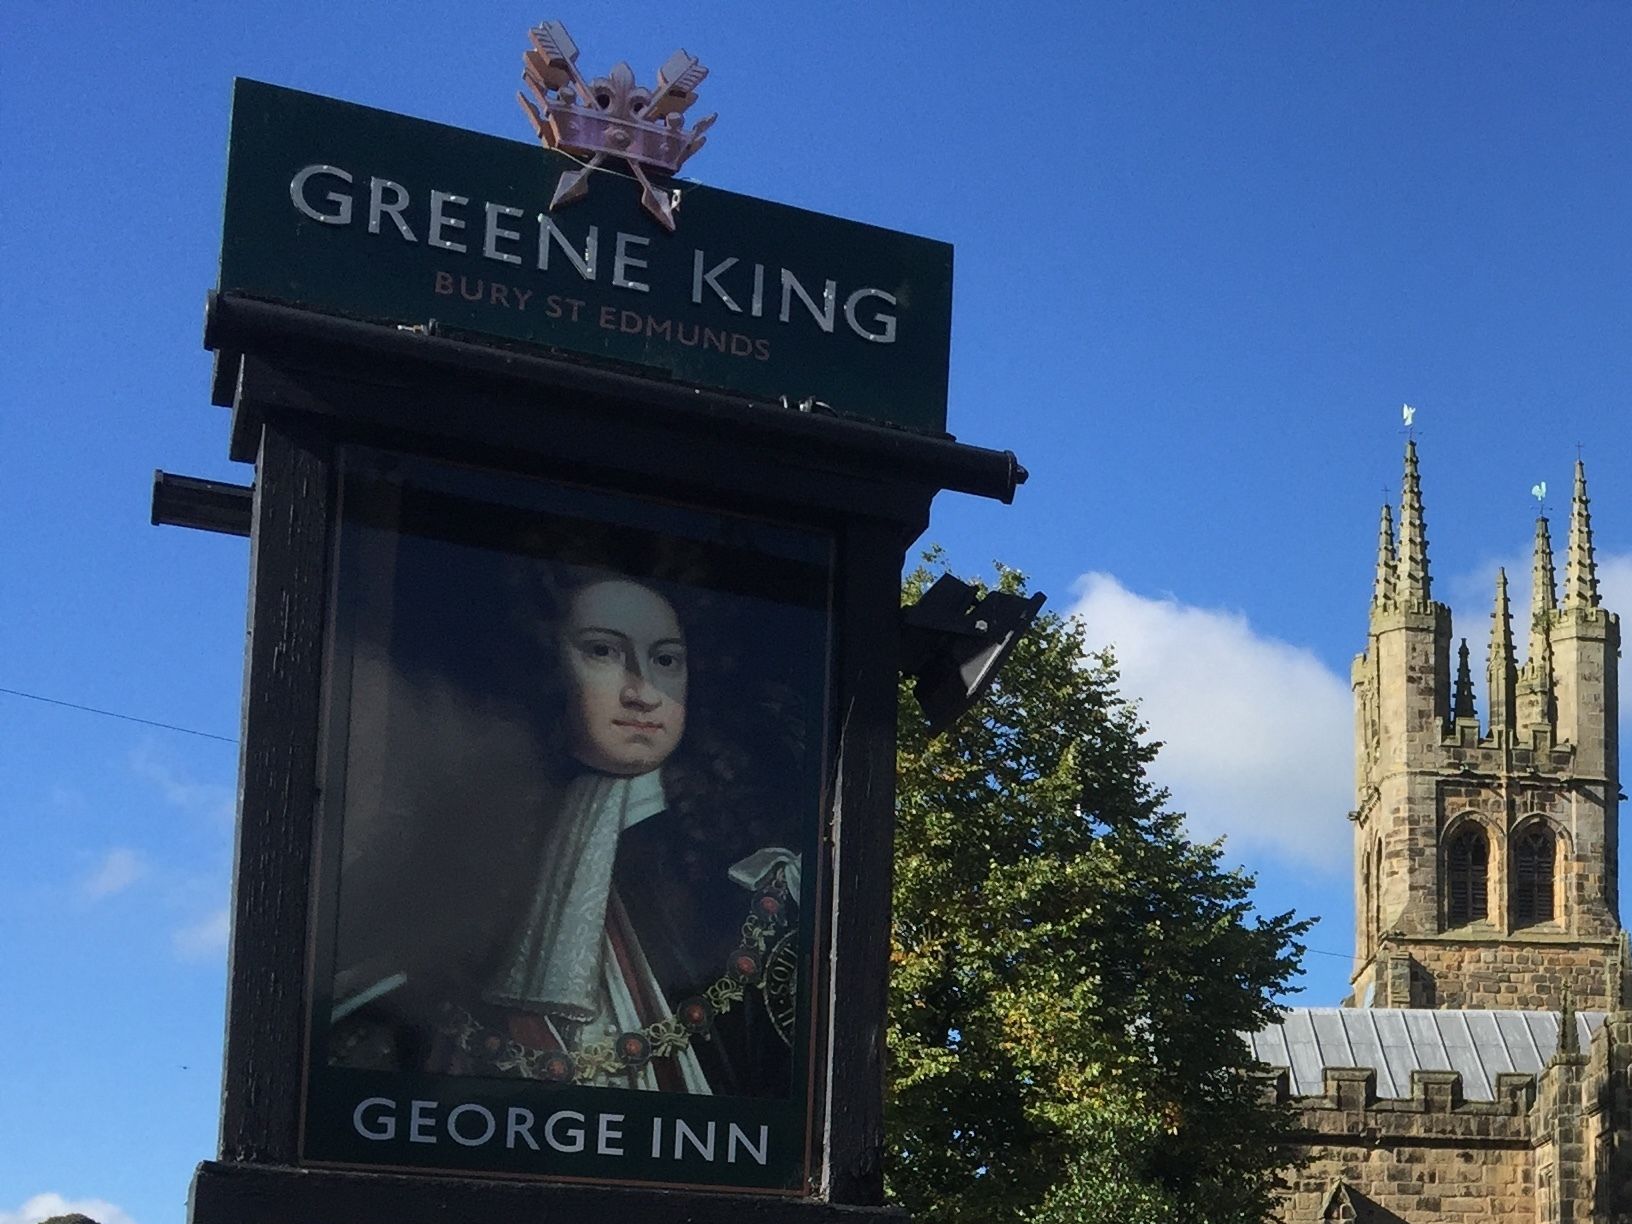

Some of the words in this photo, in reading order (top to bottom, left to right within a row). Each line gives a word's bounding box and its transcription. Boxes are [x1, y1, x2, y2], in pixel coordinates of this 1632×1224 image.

[289, 163, 652, 293] GREENE
[690, 247, 899, 345] KING
[433, 270, 532, 312] BURY
[546, 297, 585, 322] ST
[600, 309, 772, 362] EDMUNDS
[353, 1097, 625, 1156] GEORGE
[651, 1116, 770, 1166] INN
